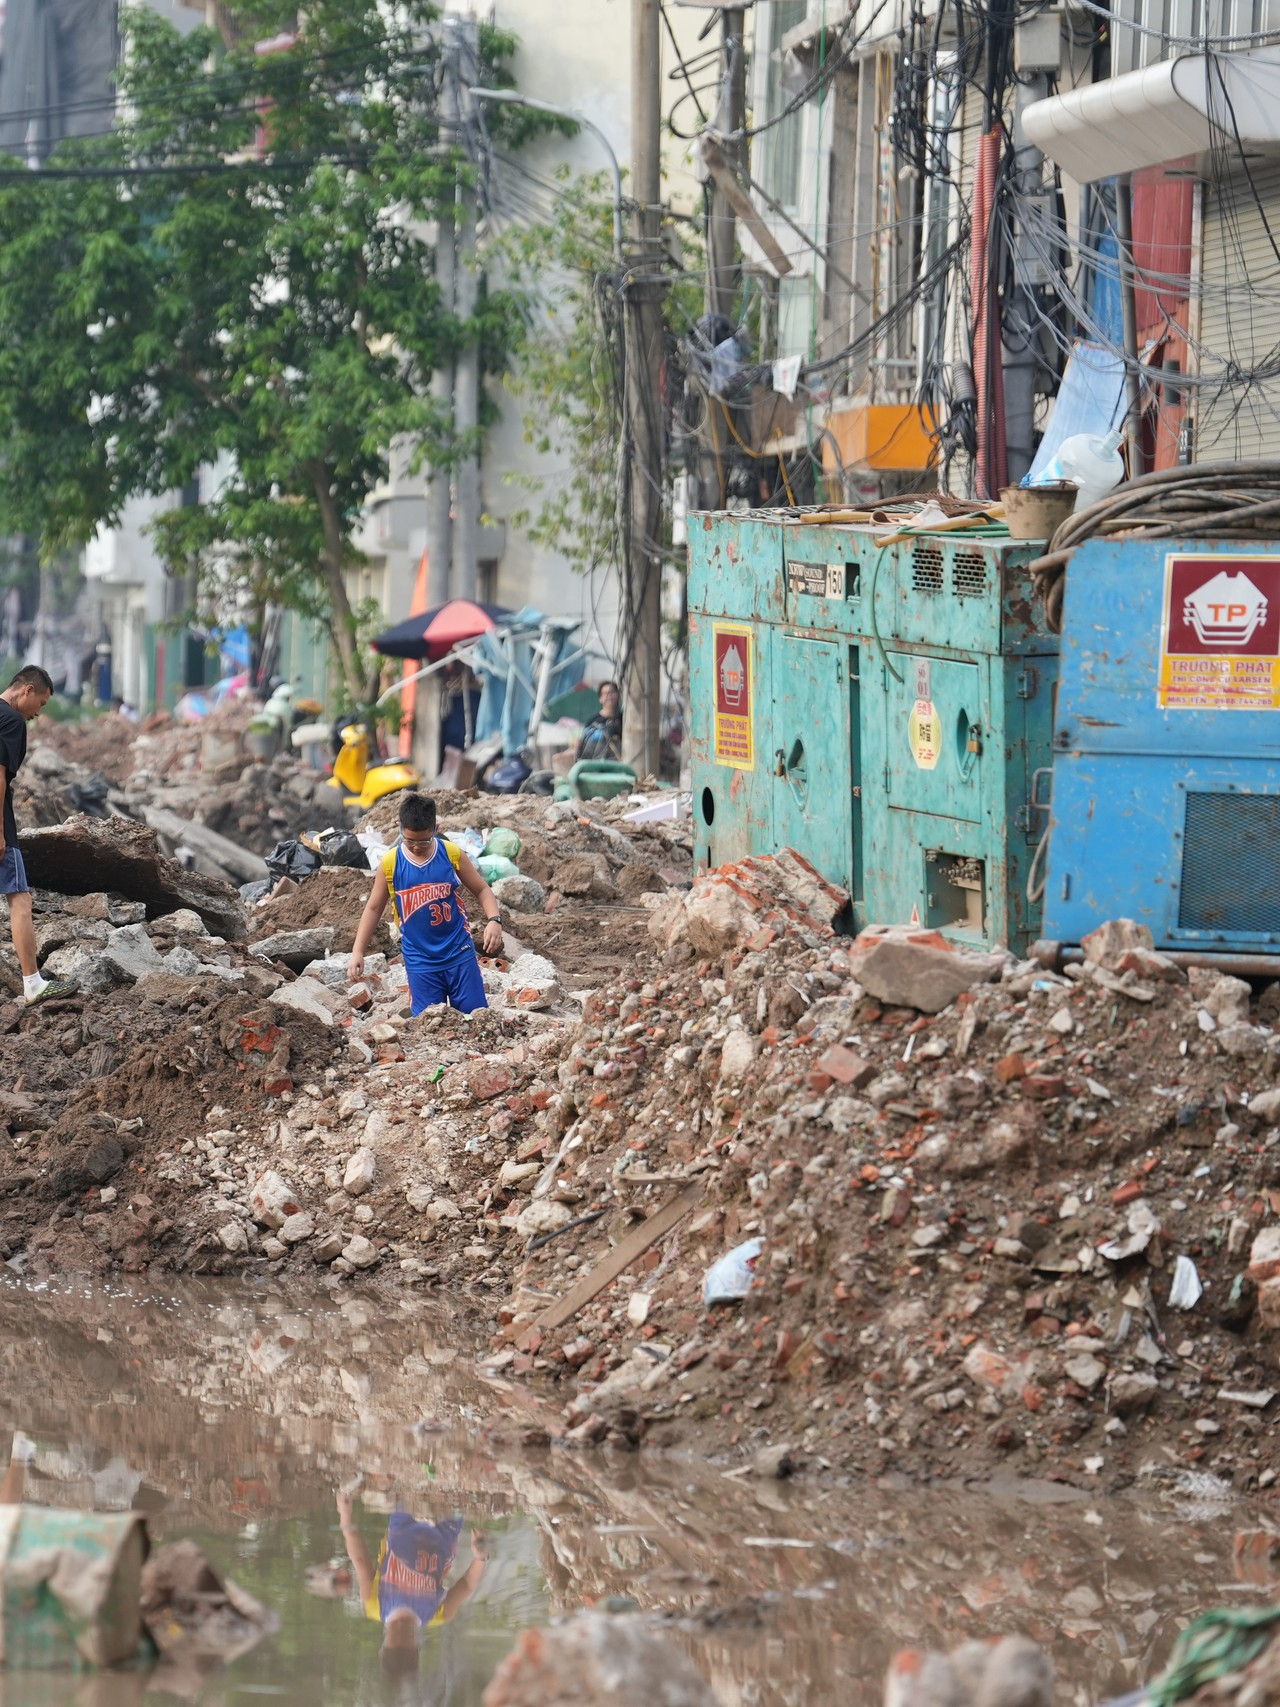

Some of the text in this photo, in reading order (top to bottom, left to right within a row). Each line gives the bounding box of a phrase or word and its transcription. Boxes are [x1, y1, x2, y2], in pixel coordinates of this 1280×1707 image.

[828, 569, 842, 595] 150
[1208, 604, 1247, 622] TP
[728, 671, 738, 686] TP
[1234, 675, 1271, 684] LARSEN
[917, 682, 928, 696] 01
[396, 883, 451, 922] WARRIORS
[429, 902, 451, 925] 30
